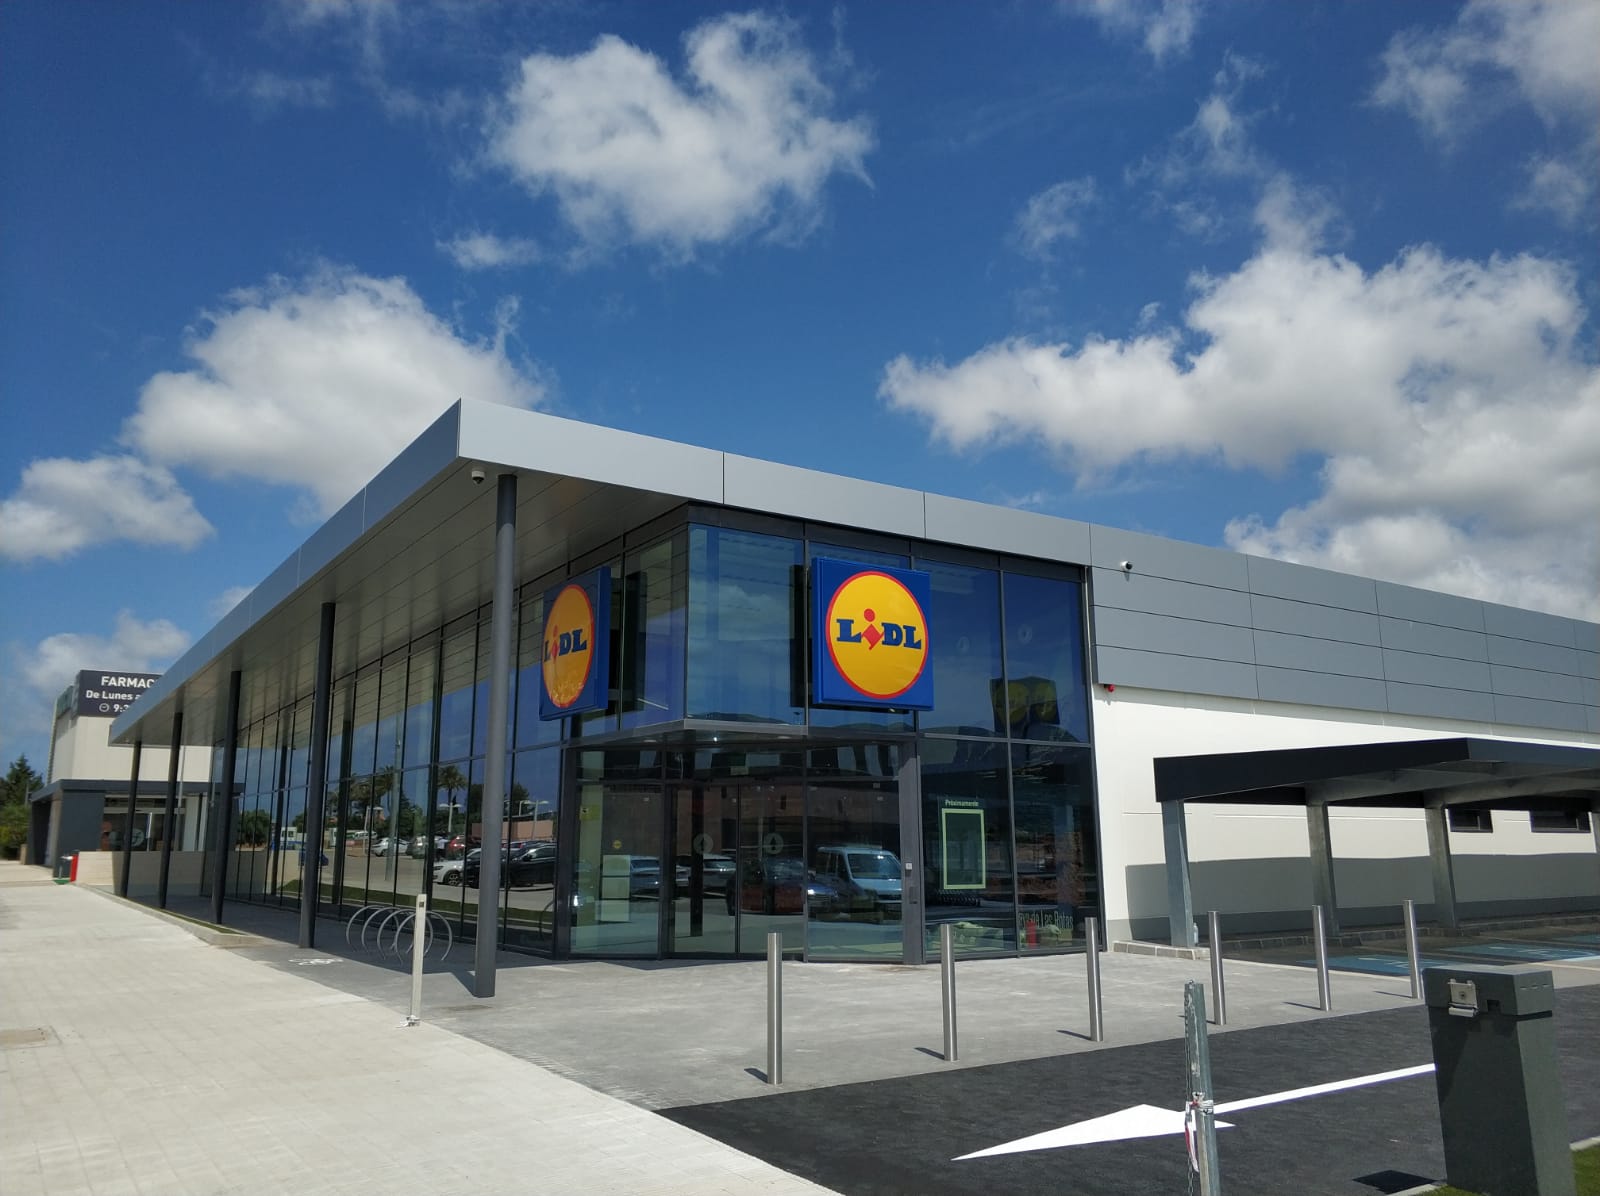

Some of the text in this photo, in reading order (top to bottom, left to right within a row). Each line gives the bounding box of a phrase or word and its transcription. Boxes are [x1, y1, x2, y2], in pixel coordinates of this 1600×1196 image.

[101, 676, 156, 689] FARMAC
[86, 690, 100, 699] De
[102, 691, 134, 700] Lunes
